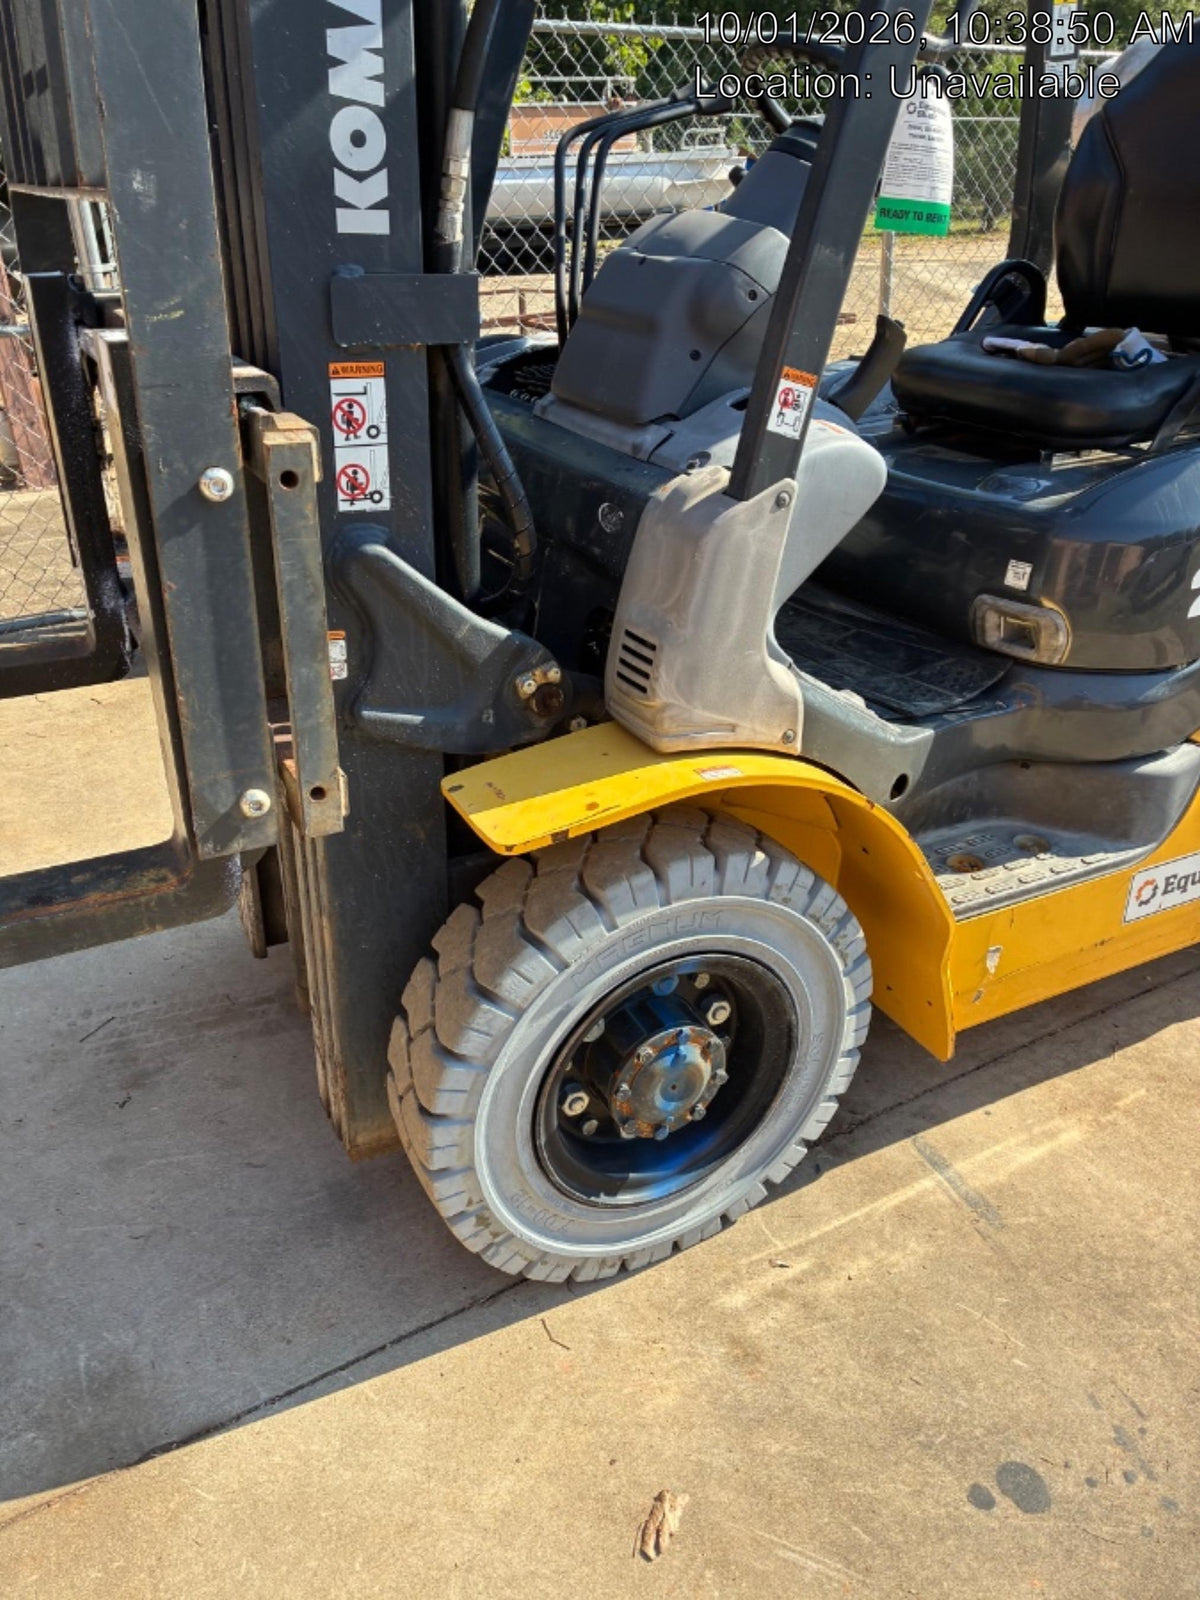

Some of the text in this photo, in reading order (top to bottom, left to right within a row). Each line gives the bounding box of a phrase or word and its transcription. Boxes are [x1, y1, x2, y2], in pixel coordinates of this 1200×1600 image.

[879, 207, 948, 225] READY TO RENT
[341, 364, 383, 374] WARNING
